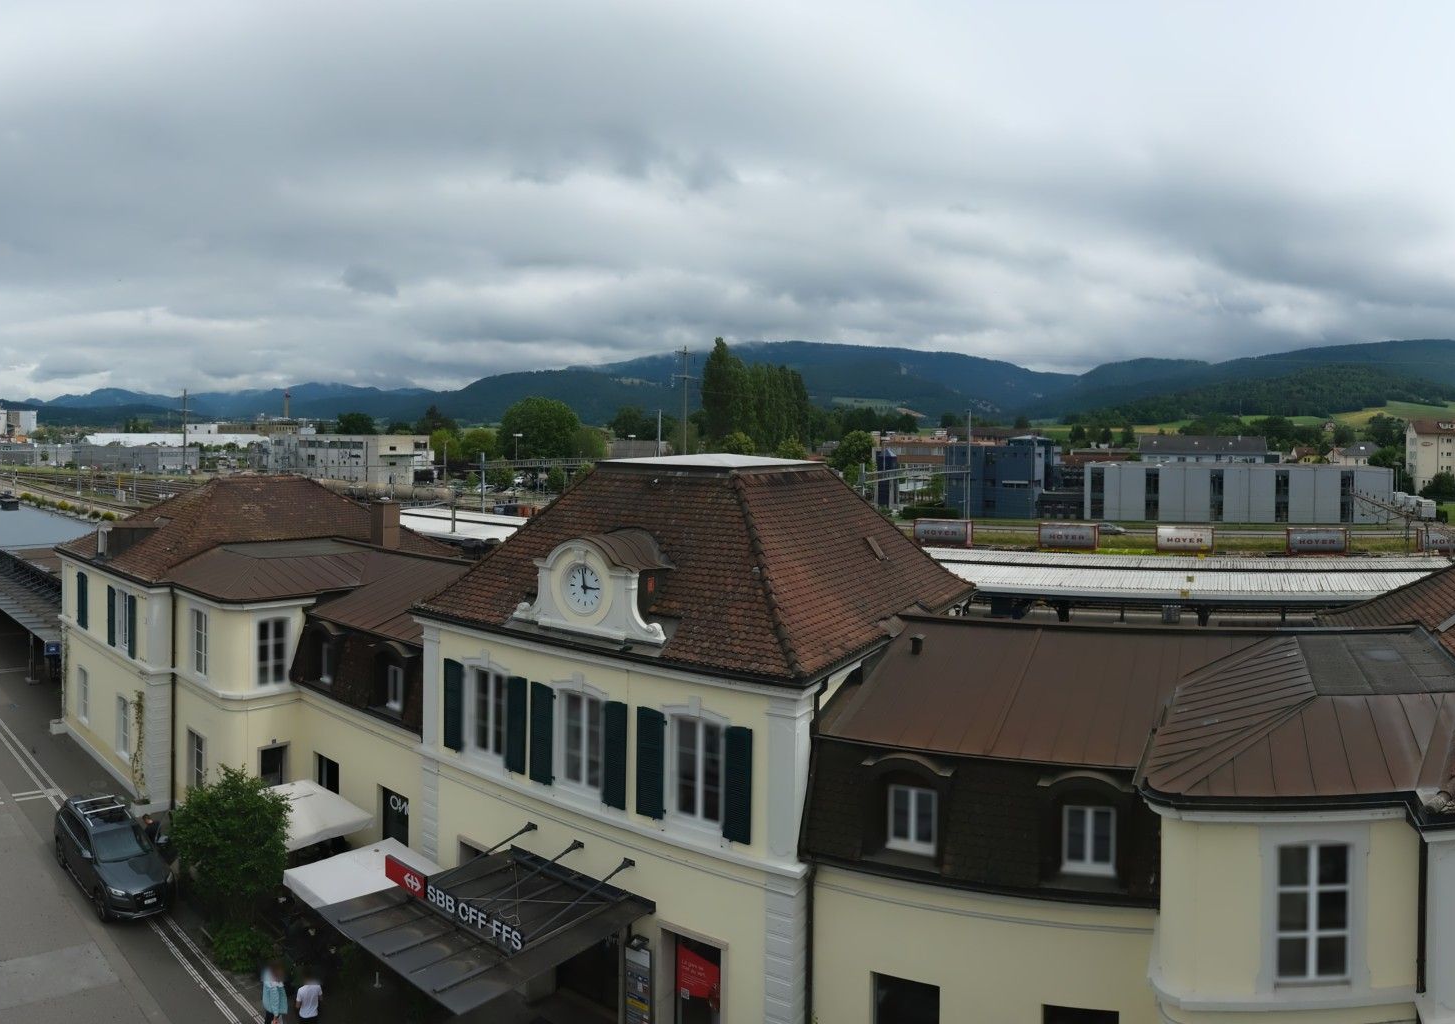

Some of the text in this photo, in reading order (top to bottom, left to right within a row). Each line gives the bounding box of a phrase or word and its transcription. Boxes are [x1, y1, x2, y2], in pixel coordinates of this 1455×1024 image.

[427, 884, 522, 951] SBB CFF FFS
